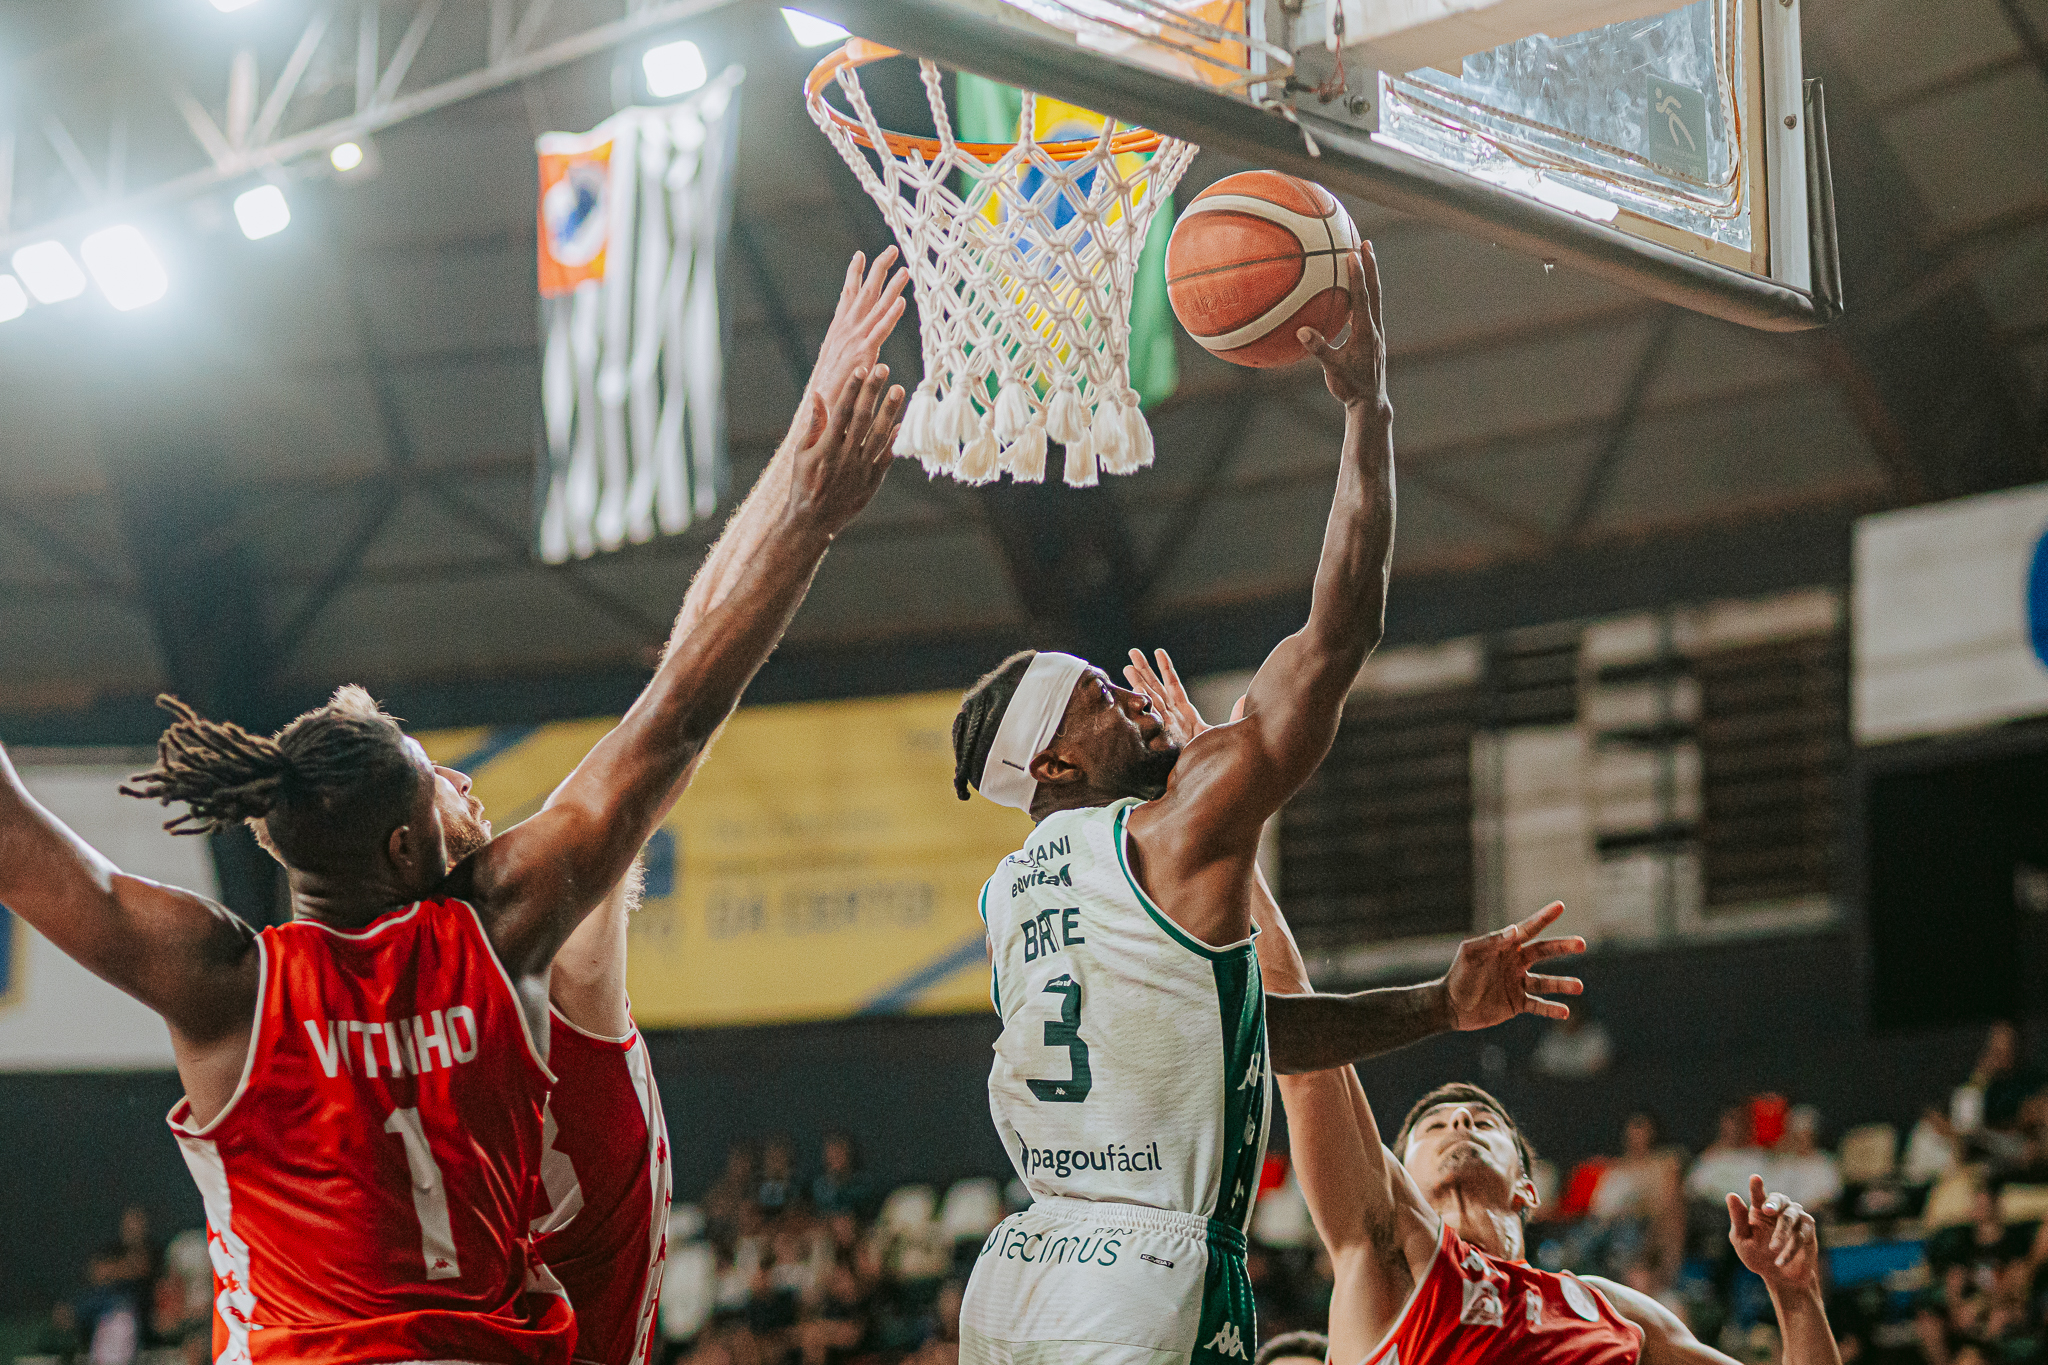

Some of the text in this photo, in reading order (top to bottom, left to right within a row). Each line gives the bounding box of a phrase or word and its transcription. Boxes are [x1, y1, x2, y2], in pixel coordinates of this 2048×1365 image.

[1026, 973, 1092, 1103] 3
[384, 1107, 460, 1280] 1
[1031, 1142, 1162, 1178] pagoufácil
